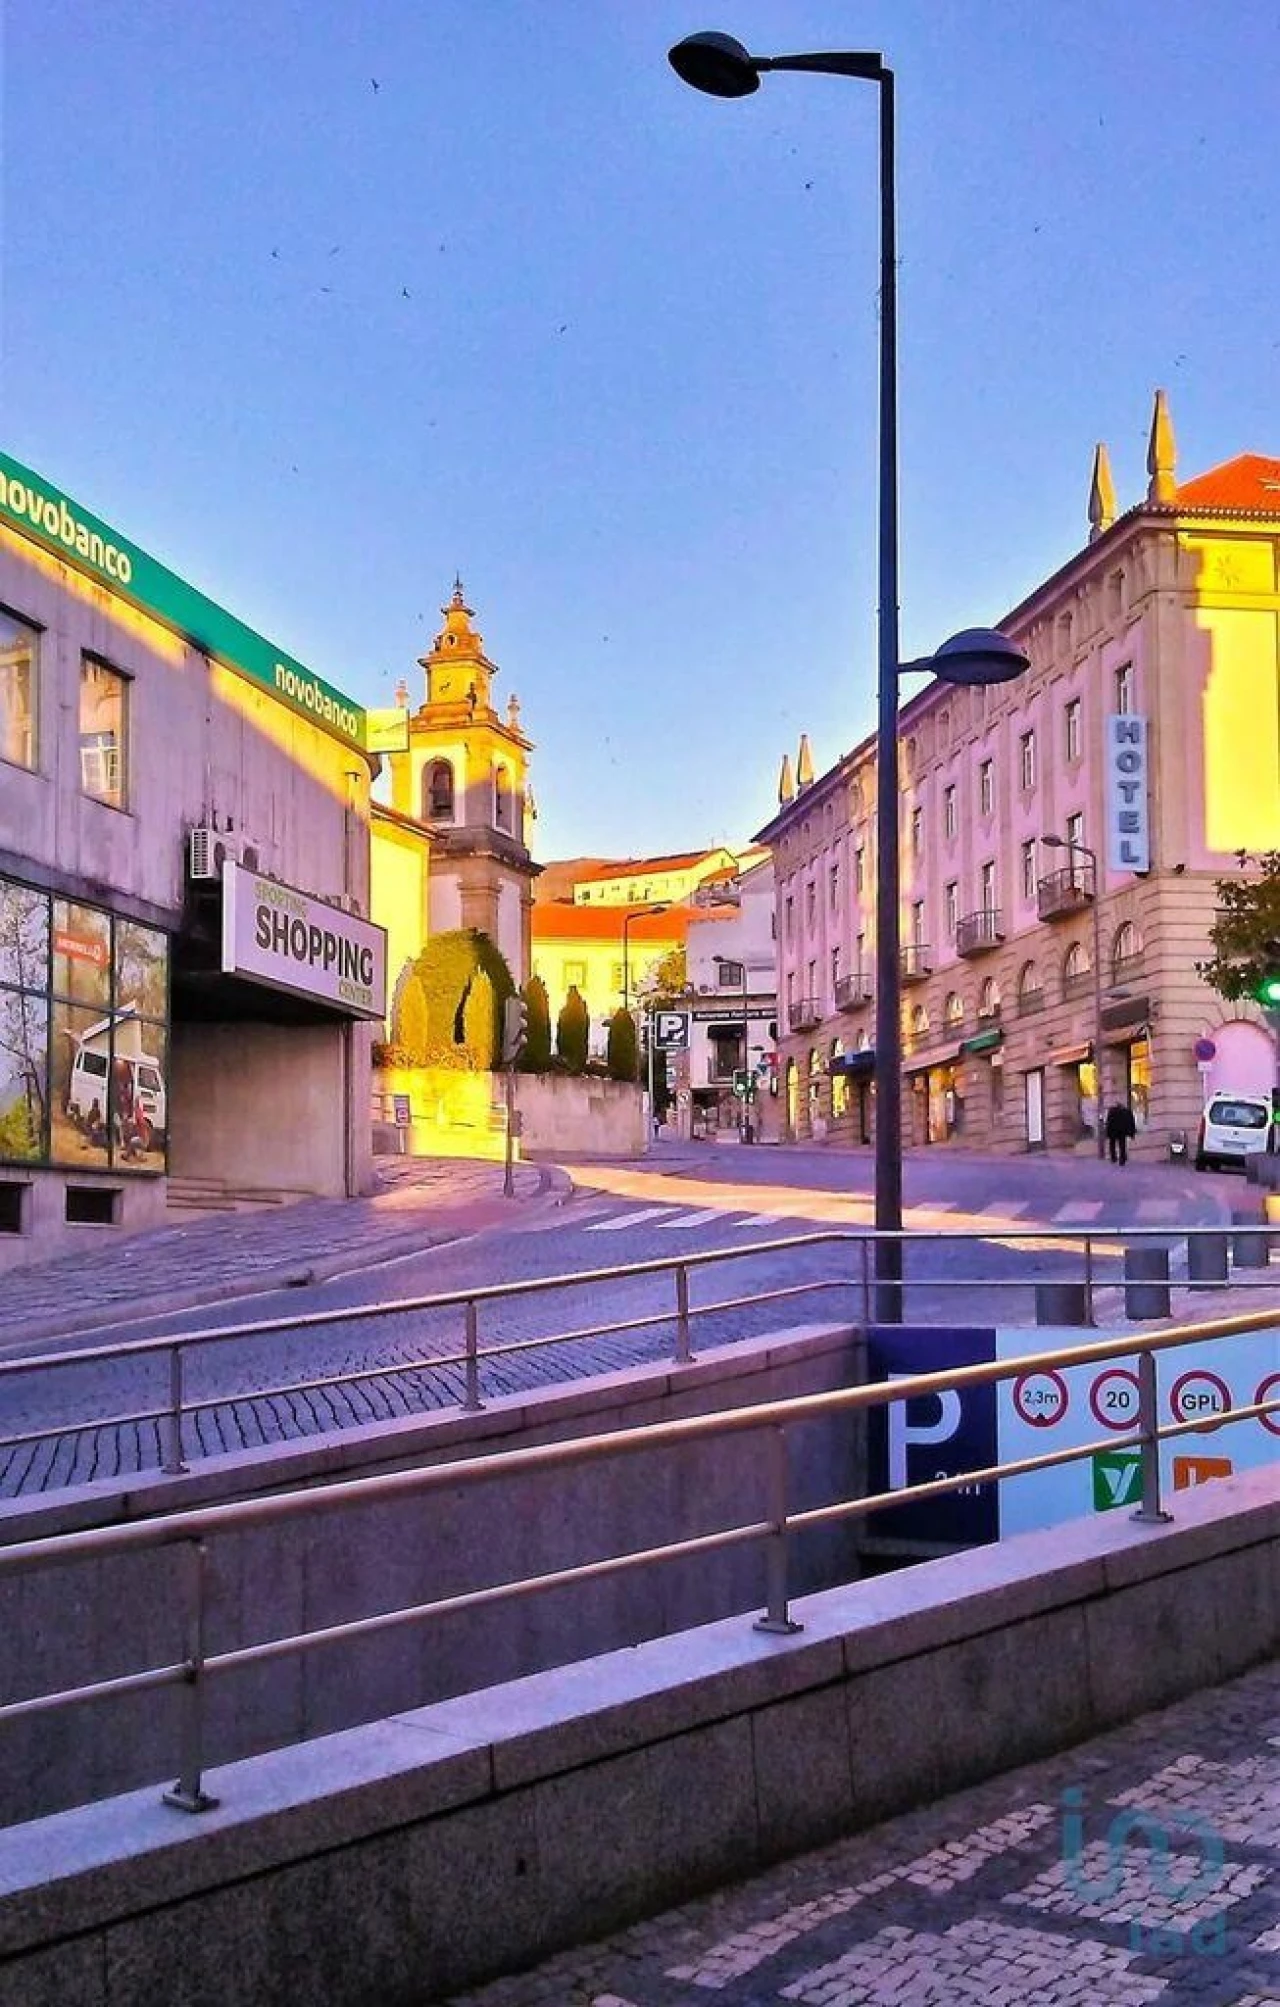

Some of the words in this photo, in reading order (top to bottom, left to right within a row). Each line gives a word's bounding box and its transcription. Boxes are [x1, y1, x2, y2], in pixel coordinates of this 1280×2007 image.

[275, 663, 357, 737] novobanco
[1115, 711, 1141, 863] HOTEL
[256, 905, 373, 986] SHOPPING
[660, 1015, 683, 1038] P
[888, 1374, 961, 1490] P
[1106, 1391, 1130, 1408] 20
[1181, 1393, 1220, 1412] GPL
